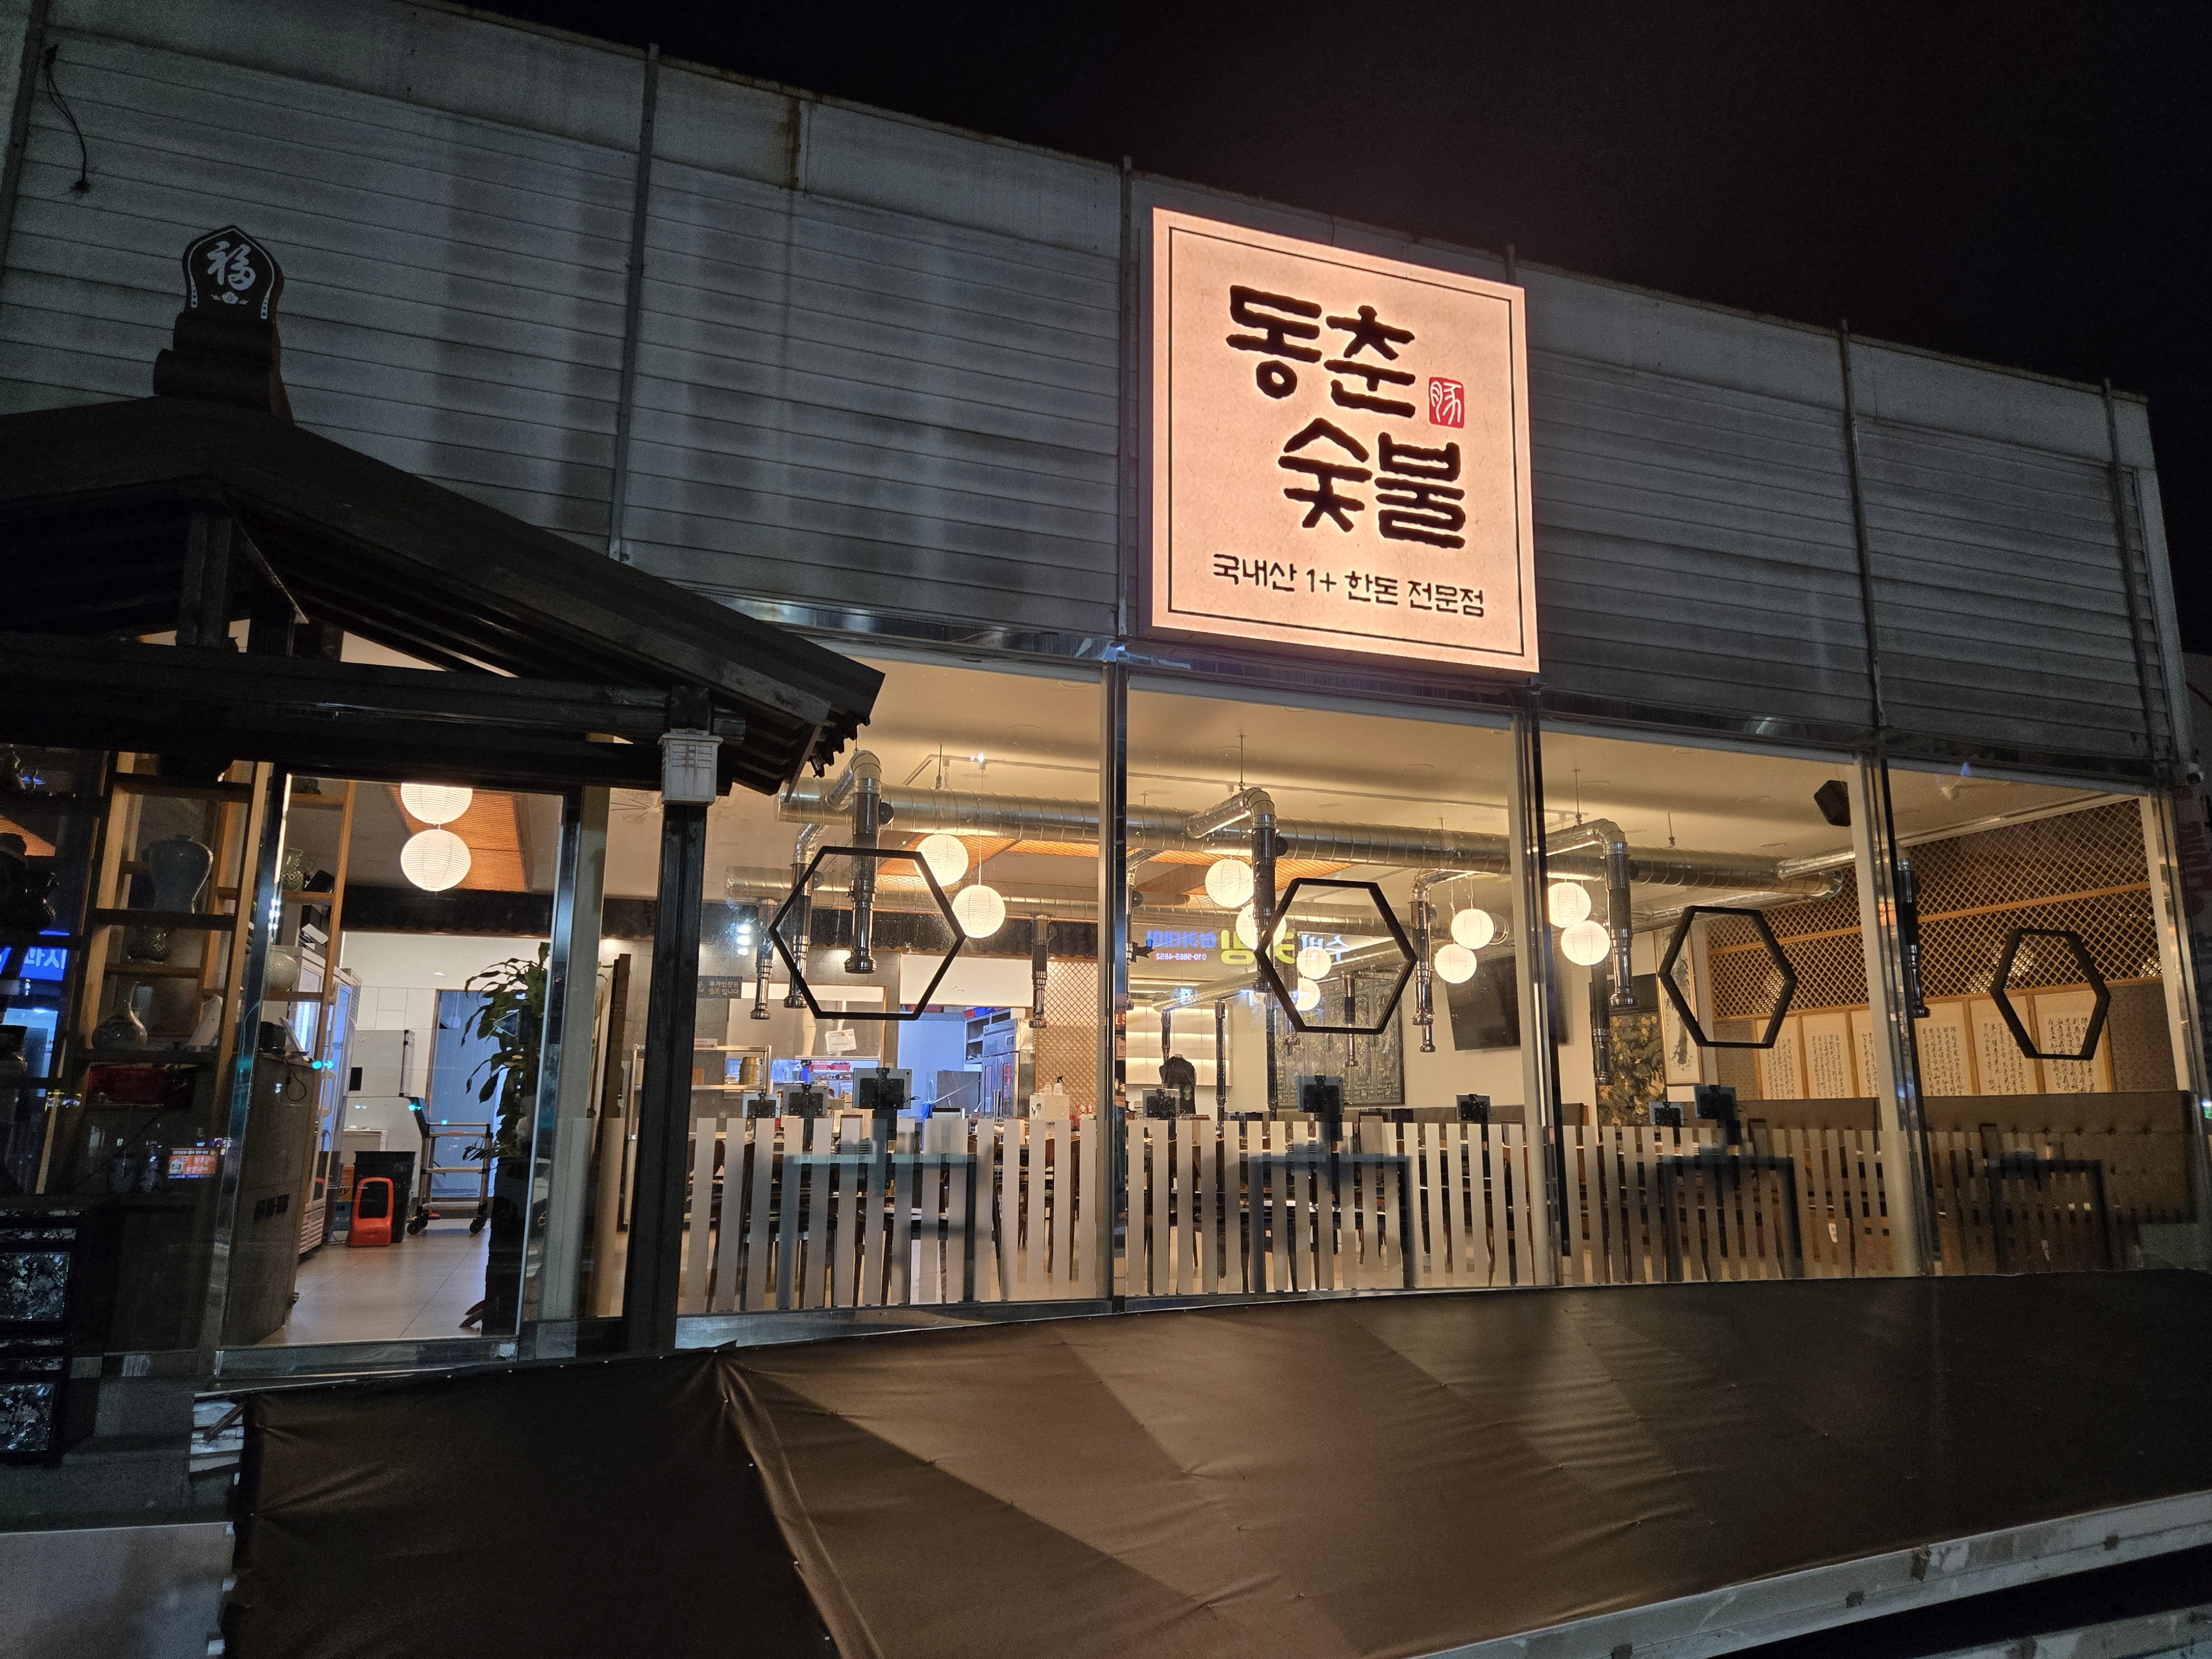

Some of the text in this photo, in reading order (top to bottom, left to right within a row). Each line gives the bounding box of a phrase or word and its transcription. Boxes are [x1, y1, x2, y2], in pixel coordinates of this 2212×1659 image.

[206, 241, 256, 291] 福
[1226, 285, 1415, 419] 동춘
[1279, 418, 1466, 549] 숯불
[1213, 554, 1484, 618] 국내산 1+ 한돈 전문점
